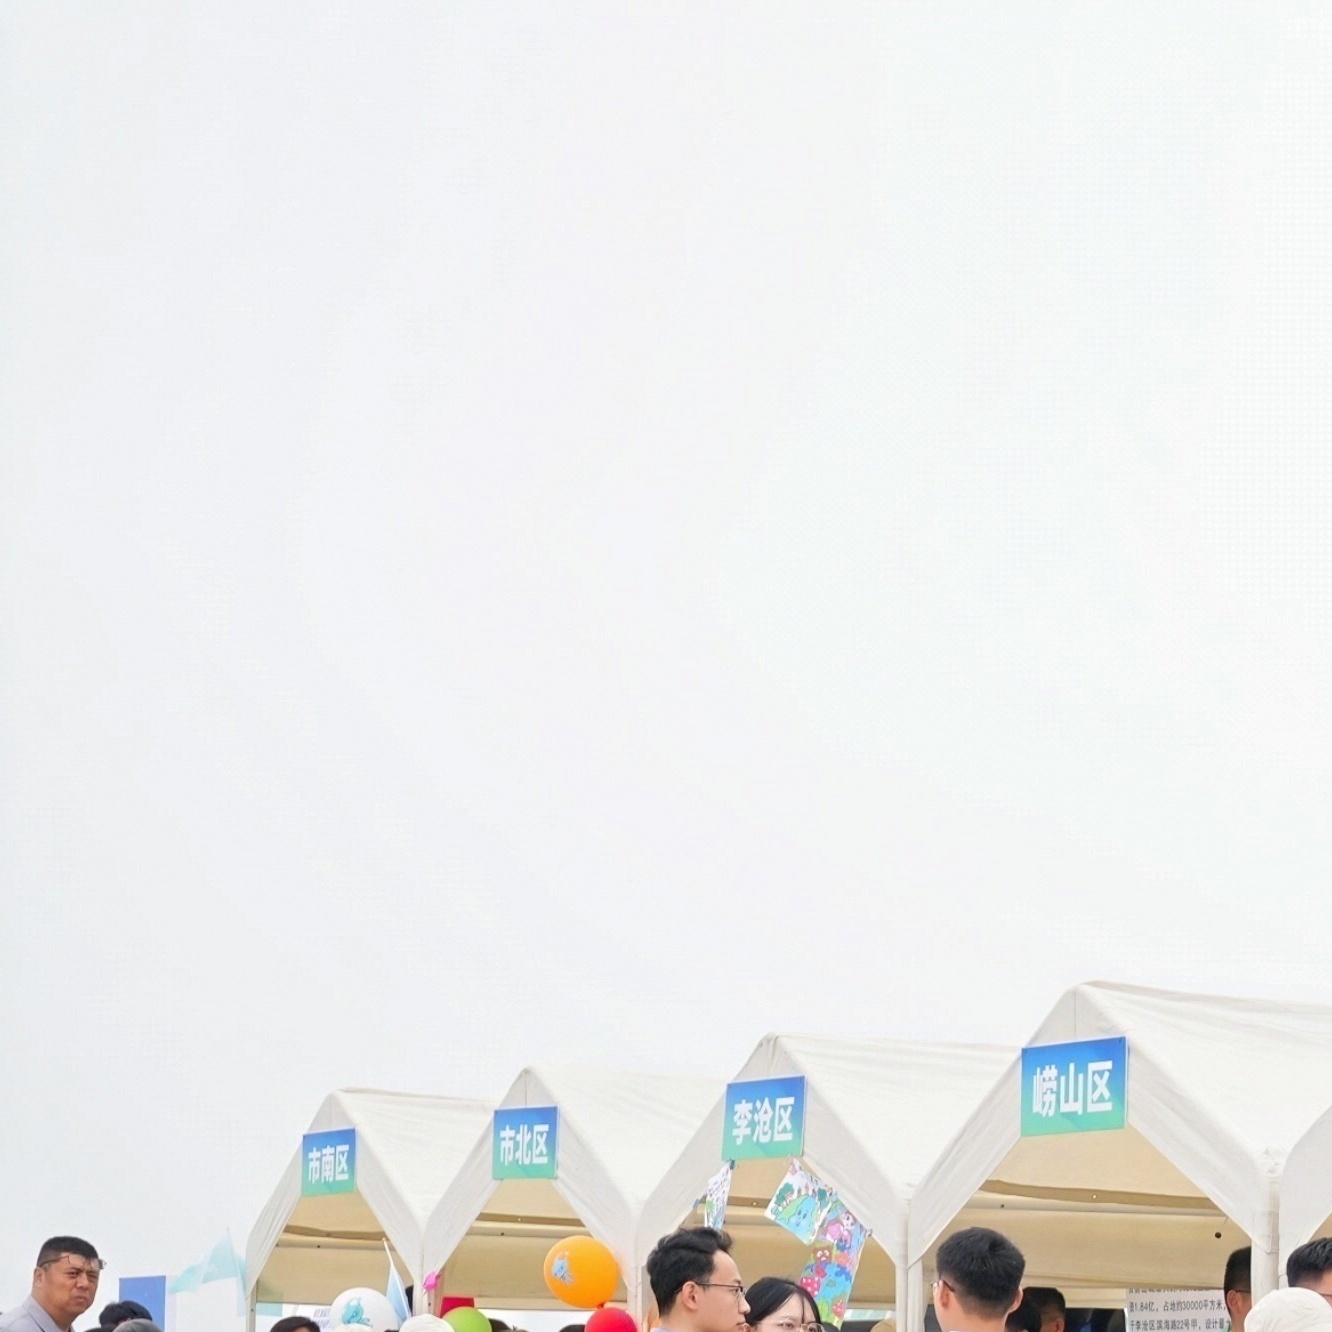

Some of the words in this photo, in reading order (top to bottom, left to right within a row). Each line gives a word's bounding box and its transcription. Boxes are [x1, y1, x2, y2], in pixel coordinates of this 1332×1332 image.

[1032, 1060, 1113, 1118] 崂山区
[732, 1096, 795, 1146] 李沧区
[308, 1144, 350, 1184] 市南区
[500, 1123, 549, 1166] 市北区
